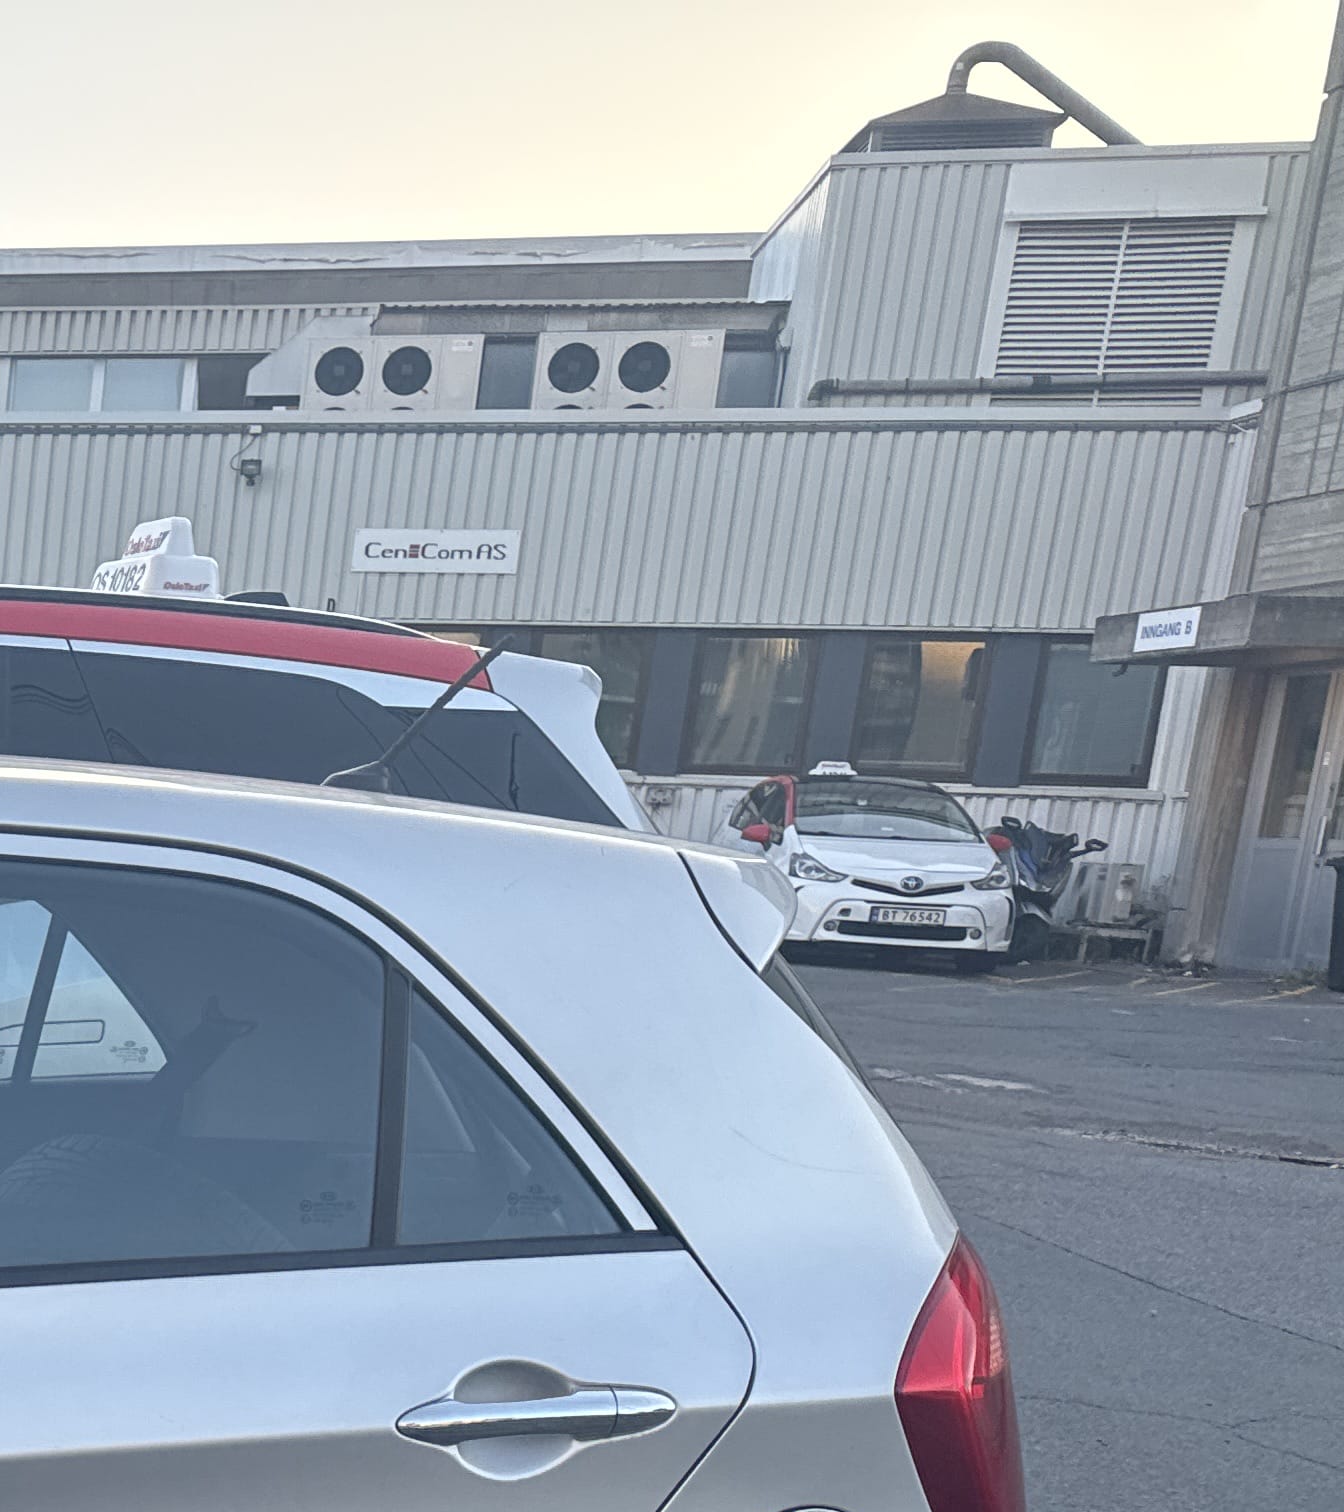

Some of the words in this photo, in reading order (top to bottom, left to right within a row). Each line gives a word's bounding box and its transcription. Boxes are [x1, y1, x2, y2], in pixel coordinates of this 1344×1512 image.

[476, 543, 508, 560] AS
[110, 563, 147, 593] 10182
[1140, 621, 1182, 640] INNGANG
[1184, 620, 1193, 635] B
[882, 910, 898, 921] BT
[902, 911, 941, 923] 76542
